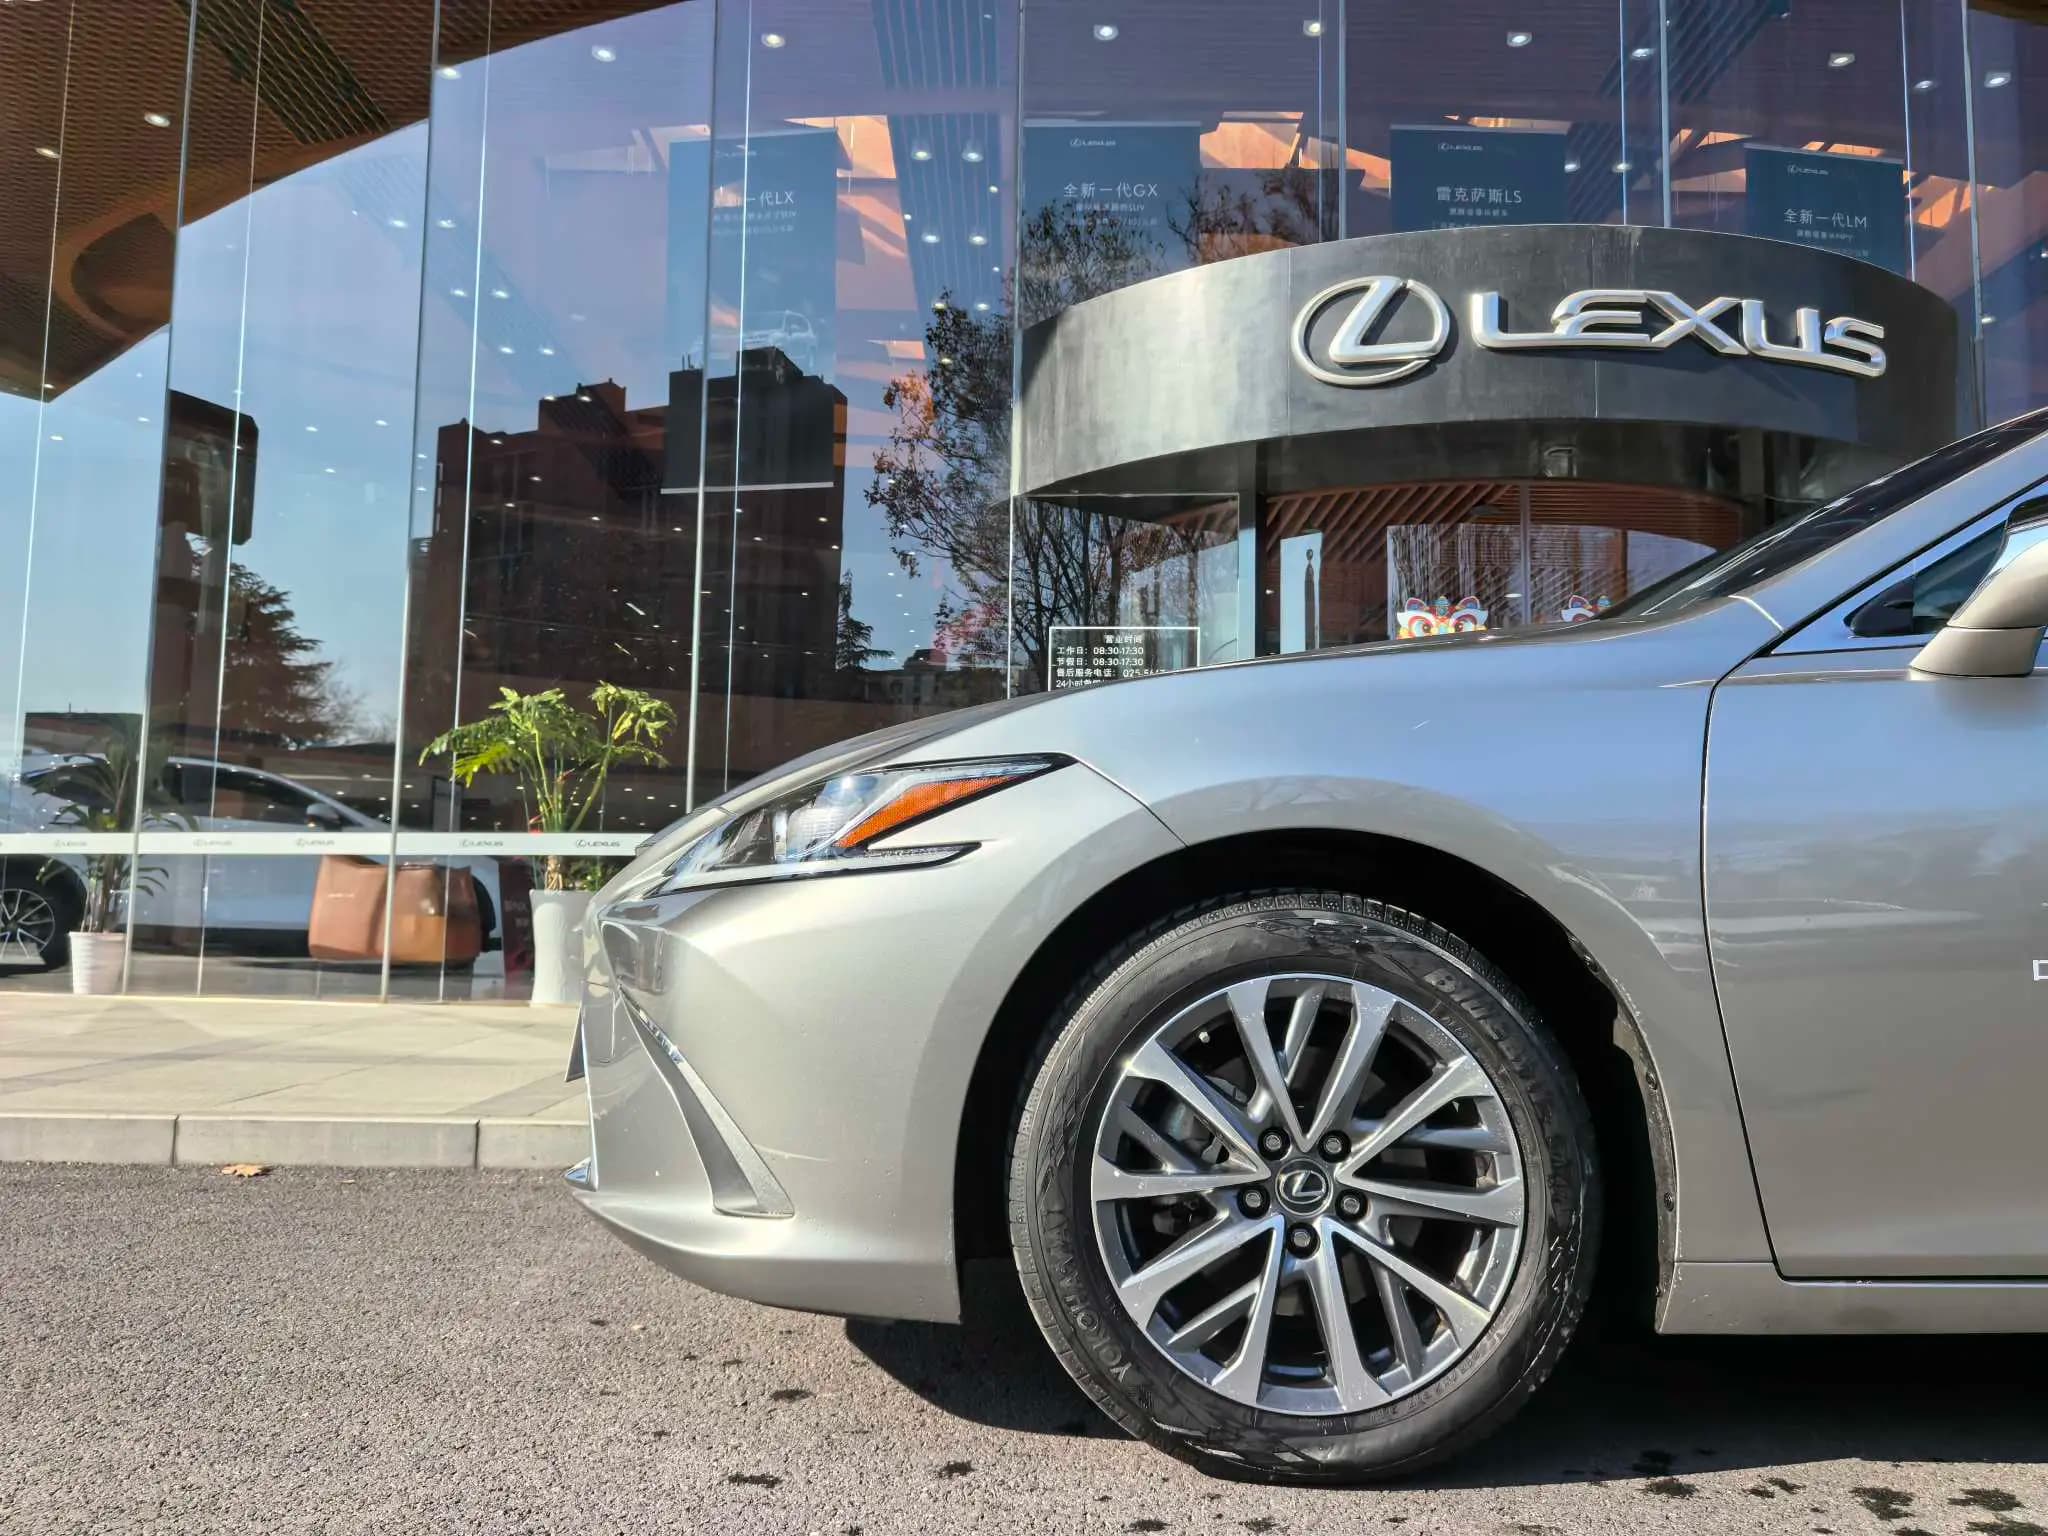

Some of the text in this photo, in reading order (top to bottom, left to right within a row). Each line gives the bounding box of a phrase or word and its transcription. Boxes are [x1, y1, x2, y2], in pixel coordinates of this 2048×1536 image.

[1063, 181, 1159, 199] 全新一代GX
[1436, 186, 1523, 204] 雷克萨斯LS
[1784, 208, 1868, 229] 全新一代LM
[1471, 289, 1887, 378] LEXUS
